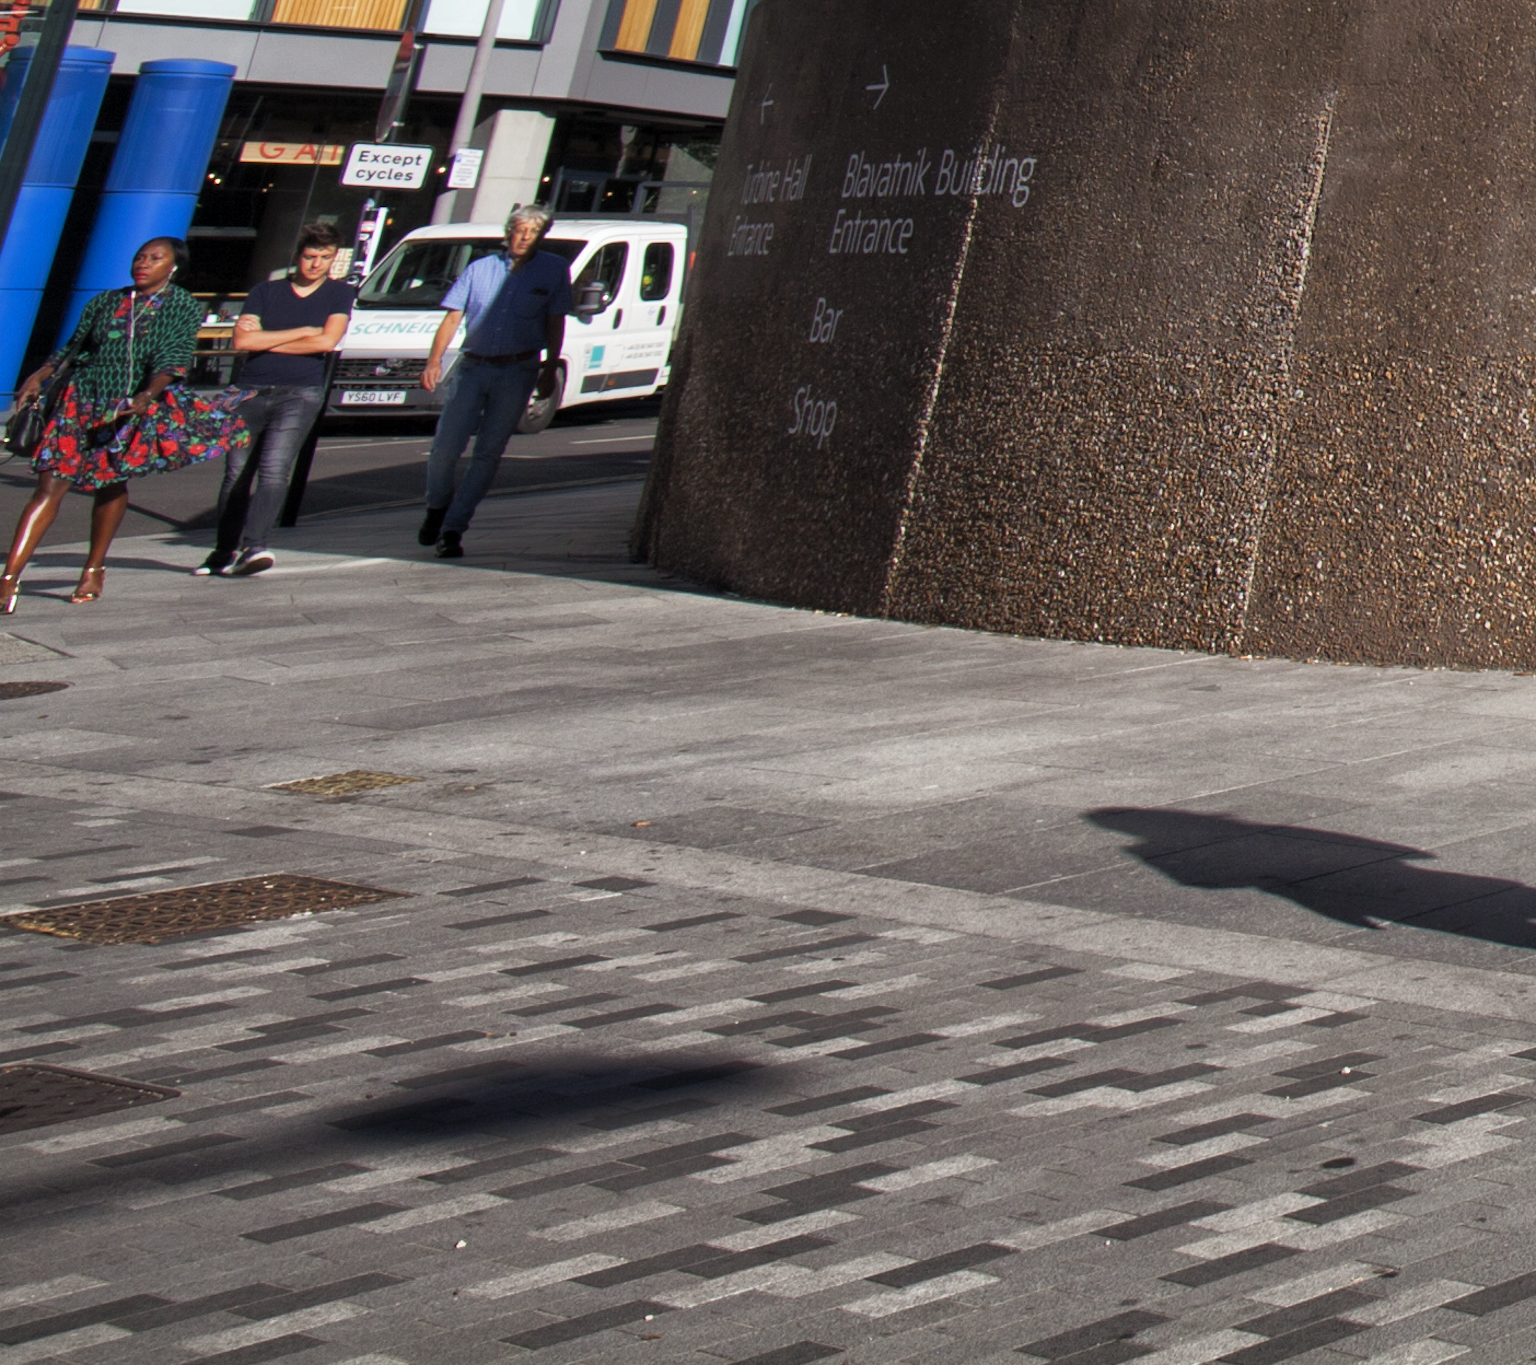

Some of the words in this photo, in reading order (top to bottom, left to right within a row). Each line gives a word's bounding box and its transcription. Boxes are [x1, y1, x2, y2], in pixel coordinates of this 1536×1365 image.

[355, 167, 415, 181] cycles
[357, 150, 424, 166] Except
[741, 158, 781, 205] Turbine
[780, 153, 813, 202] Hall
[841, 146, 932, 199] Blavatnik
[934, 143, 1038, 208] Building
[727, 215, 775, 256] Entrance
[828, 208, 915, 255] Entrance
[808, 297, 844, 343] Bar
[788, 384, 838, 450] Shop
